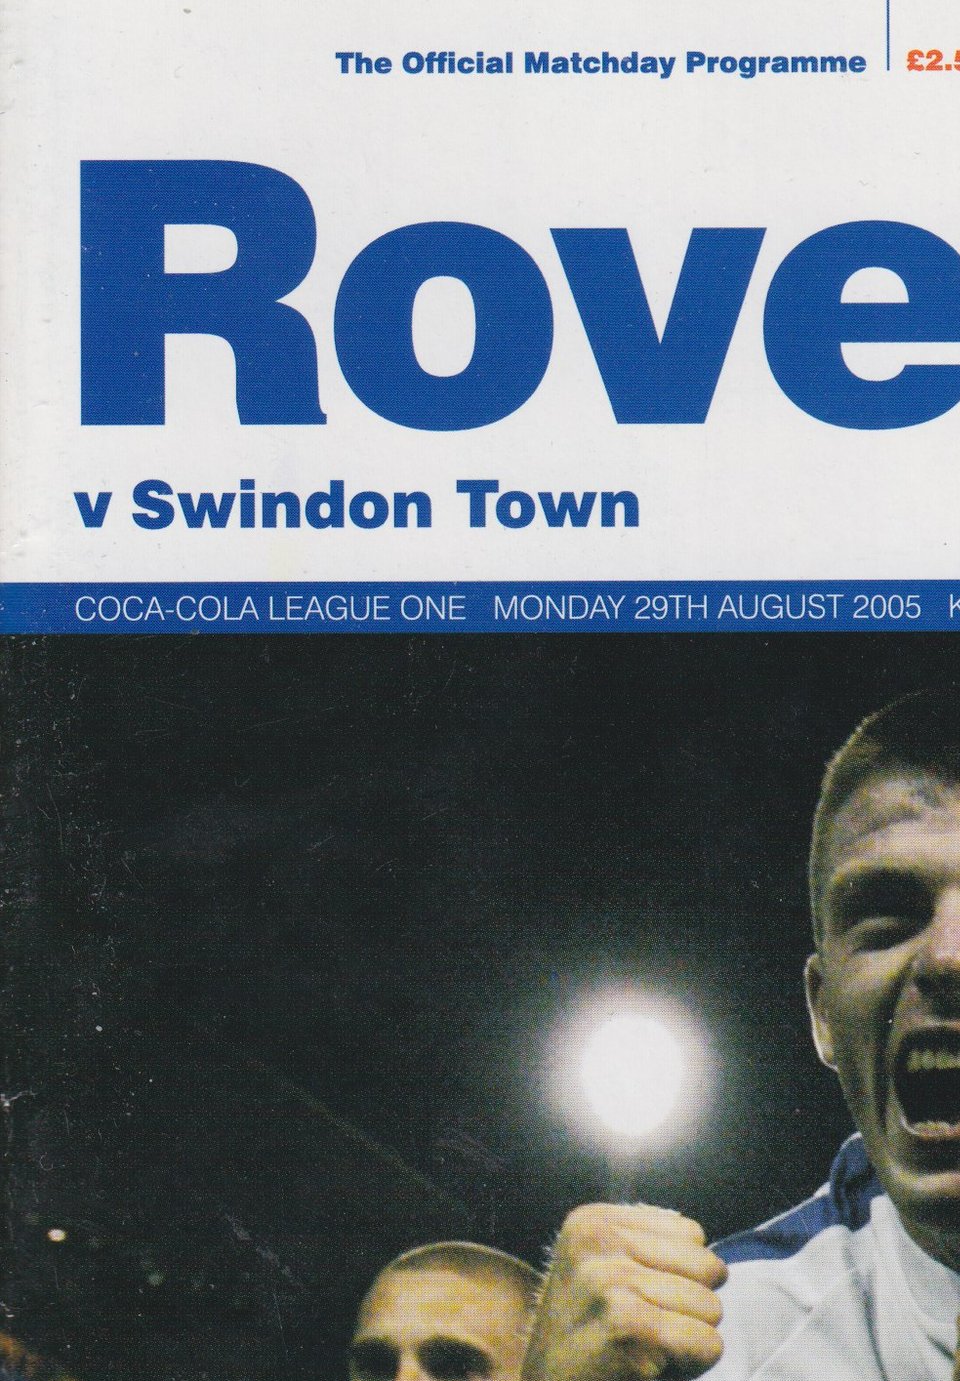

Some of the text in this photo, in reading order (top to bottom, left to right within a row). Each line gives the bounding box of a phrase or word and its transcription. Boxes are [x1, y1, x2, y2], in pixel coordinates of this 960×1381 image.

[336, 51, 865, 80] The Official Matchday Programme
[74, 480, 639, 530] v Swindon Town
[76, 595, 259, 621] COCA-COLA
[270, 595, 390, 621] LEAGUE
[401, 595, 465, 620] ONE
[495, 595, 626, 620] MONDAY
[634, 595, 708, 620] 29TH
[718, 594, 843, 619] AUGUST
[853, 595, 920, 618] 2005
